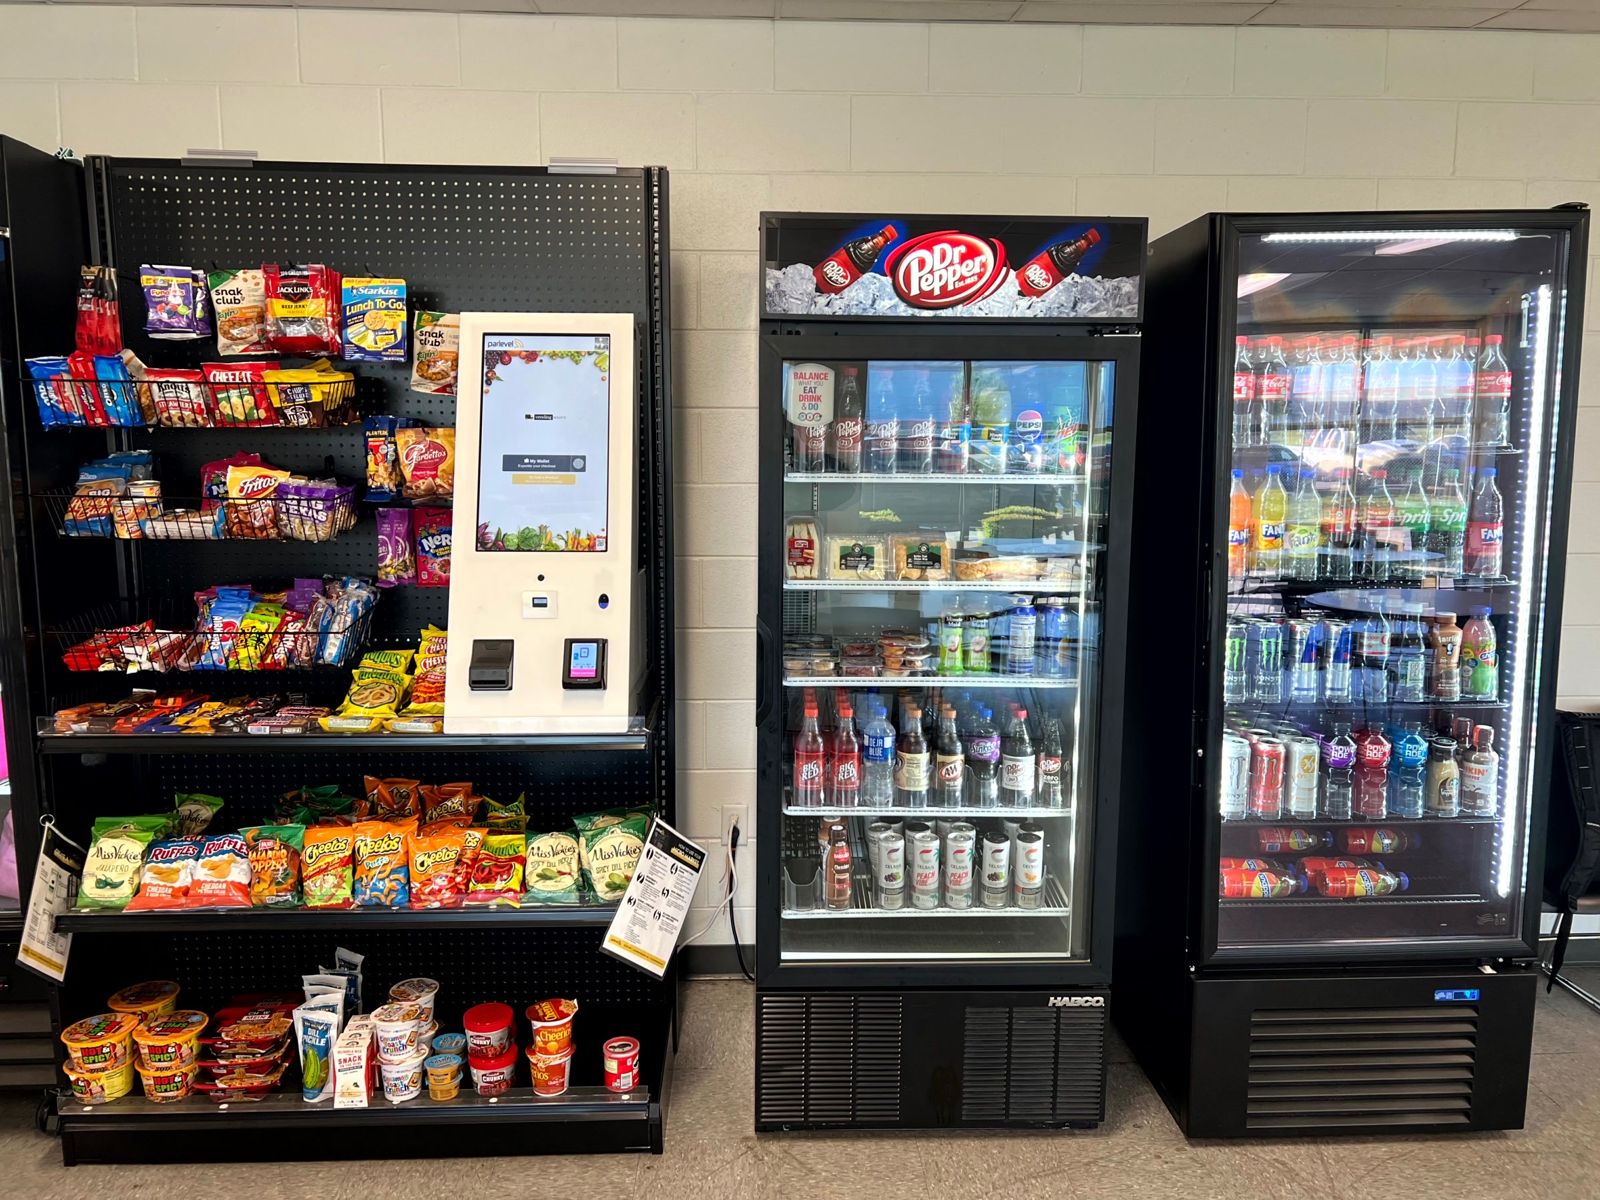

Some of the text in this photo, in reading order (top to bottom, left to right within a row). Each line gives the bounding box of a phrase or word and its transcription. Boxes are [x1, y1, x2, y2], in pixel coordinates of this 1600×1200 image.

[932, 243, 967, 271] Dr
[902, 249, 987, 297] Pepper
[215, 287, 243, 296] snak
[358, 286, 399, 296] StarKist
[215, 296, 242, 305] club
[346, 298, 404, 316] Lunch To-Go
[419, 329, 445, 339] snak
[419, 338, 441, 347] club
[488, 340, 515, 350] parlevel
[793, 372, 829, 380] BALANCE
[803, 386, 817, 394] EAT
[239, 476, 277, 498] Fritos
[869, 738, 883, 747] DEJA
[869, 747, 883, 757] BLUE
[803, 760, 817, 772] BIG
[839, 760, 854, 772] BIG
[801, 767, 819, 781] RED
[838, 767, 857, 781] RED
[1043, 774, 1059, 782] zero
[91, 844, 114, 860] Miss
[203, 837, 251, 858] RUFFLES
[304, 837, 349, 865] Cheetos
[355, 833, 402, 864] Cheetos
[528, 845, 552, 859] Miss
[150, 845, 198, 861] RUFFLES
[591, 848, 615, 862] Miss
[415, 847, 459, 875] Cheetos
[916, 871, 936, 880] PEACH
[950, 871, 969, 880] PEACH
[1048, 997, 1105, 1007] HABCO
[81, 1045, 103, 1056] HOT
[148, 1045, 168, 1054] HOT
[82, 1052, 110, 1064] SPICY
[150, 1053, 176, 1062] SPICY
[338, 1055, 363, 1065] SNACK
[154, 1074, 182, 1084] HOT &
[482, 1074, 504, 1082] CHUNKY
[155, 1082, 182, 1093] SPICY
